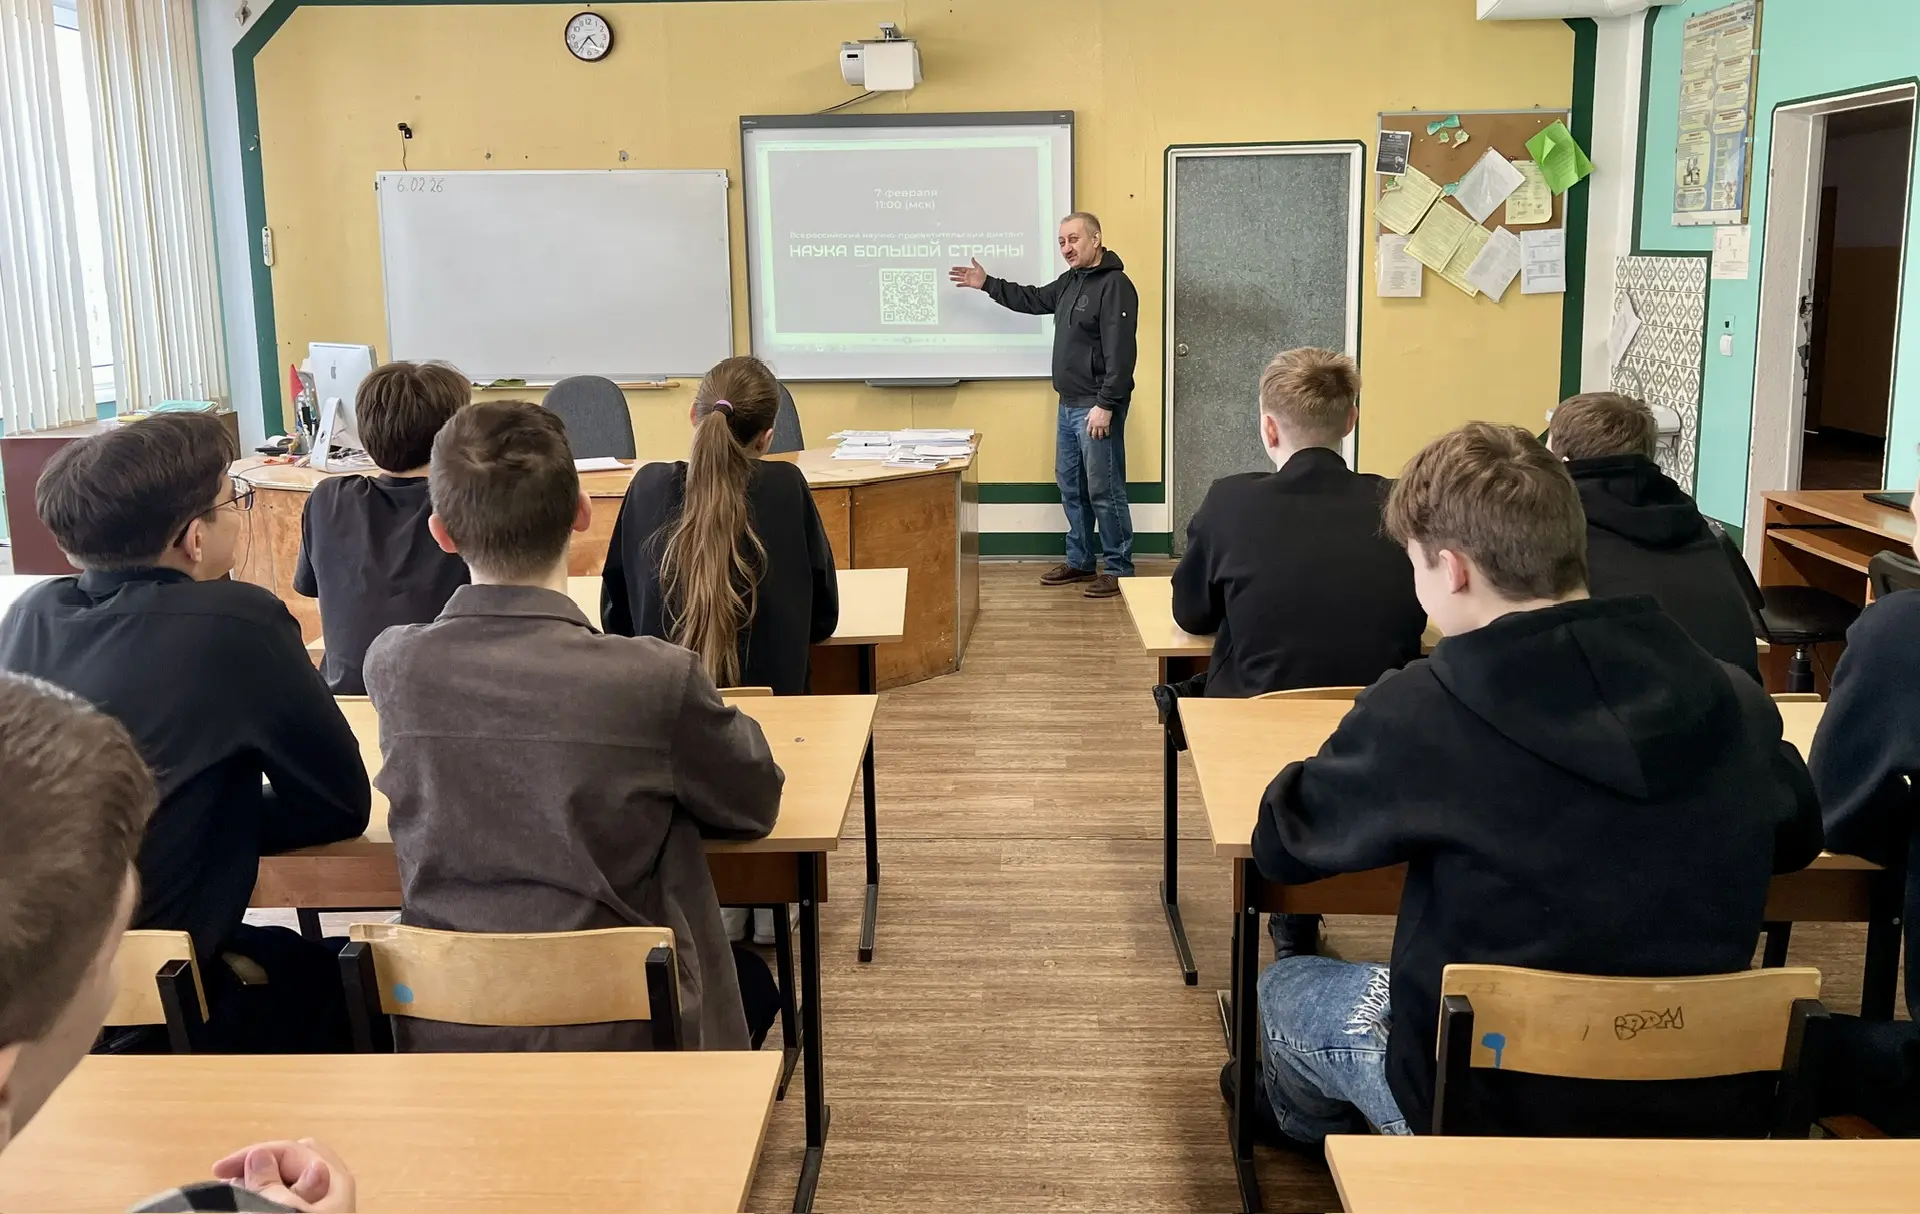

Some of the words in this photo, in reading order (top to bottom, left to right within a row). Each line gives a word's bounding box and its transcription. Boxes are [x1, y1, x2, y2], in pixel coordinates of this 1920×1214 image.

[874, 188, 881, 197] 7
[884, 188, 938, 199] февраля
[874, 200, 901, 210] 11:00
[790, 245, 847, 257] НАУКА
[854, 239, 941, 257] БОЛЬШОЙ
[948, 244, 1024, 258] СТРАНЫ
